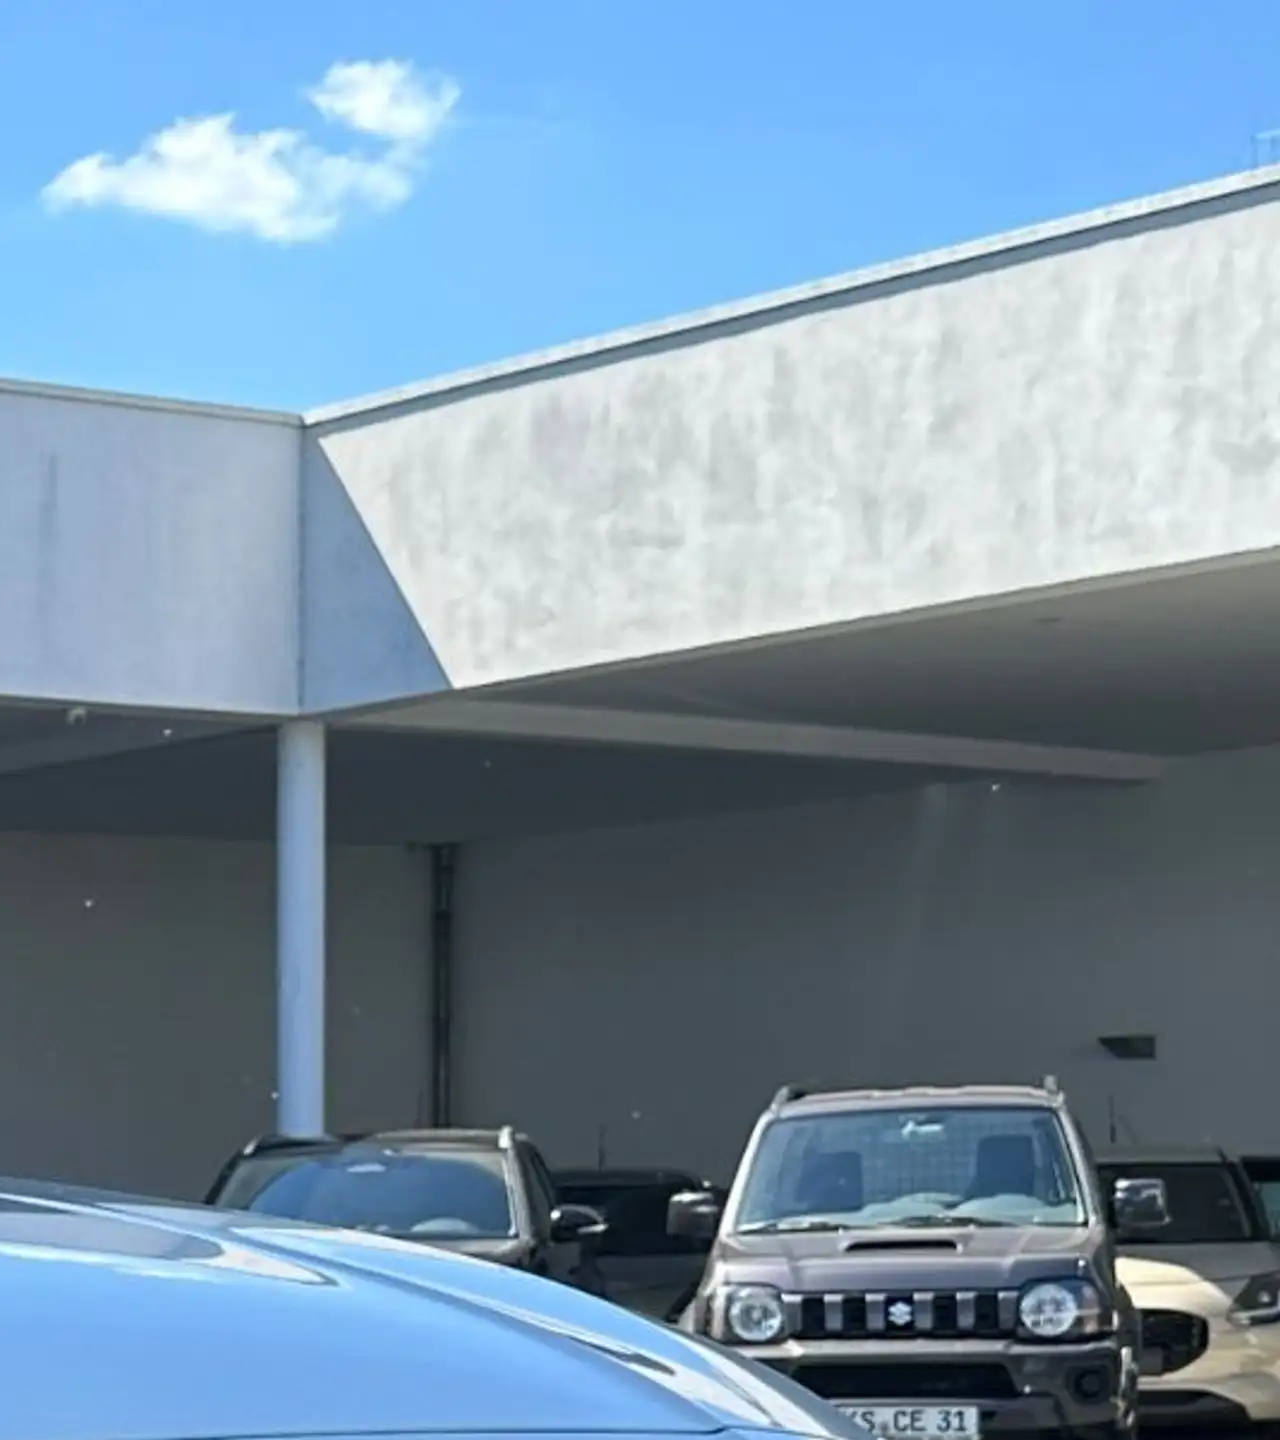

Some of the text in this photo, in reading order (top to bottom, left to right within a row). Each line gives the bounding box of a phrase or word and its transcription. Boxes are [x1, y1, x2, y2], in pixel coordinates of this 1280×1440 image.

[847, 1410, 966, 1433] S CE 31
